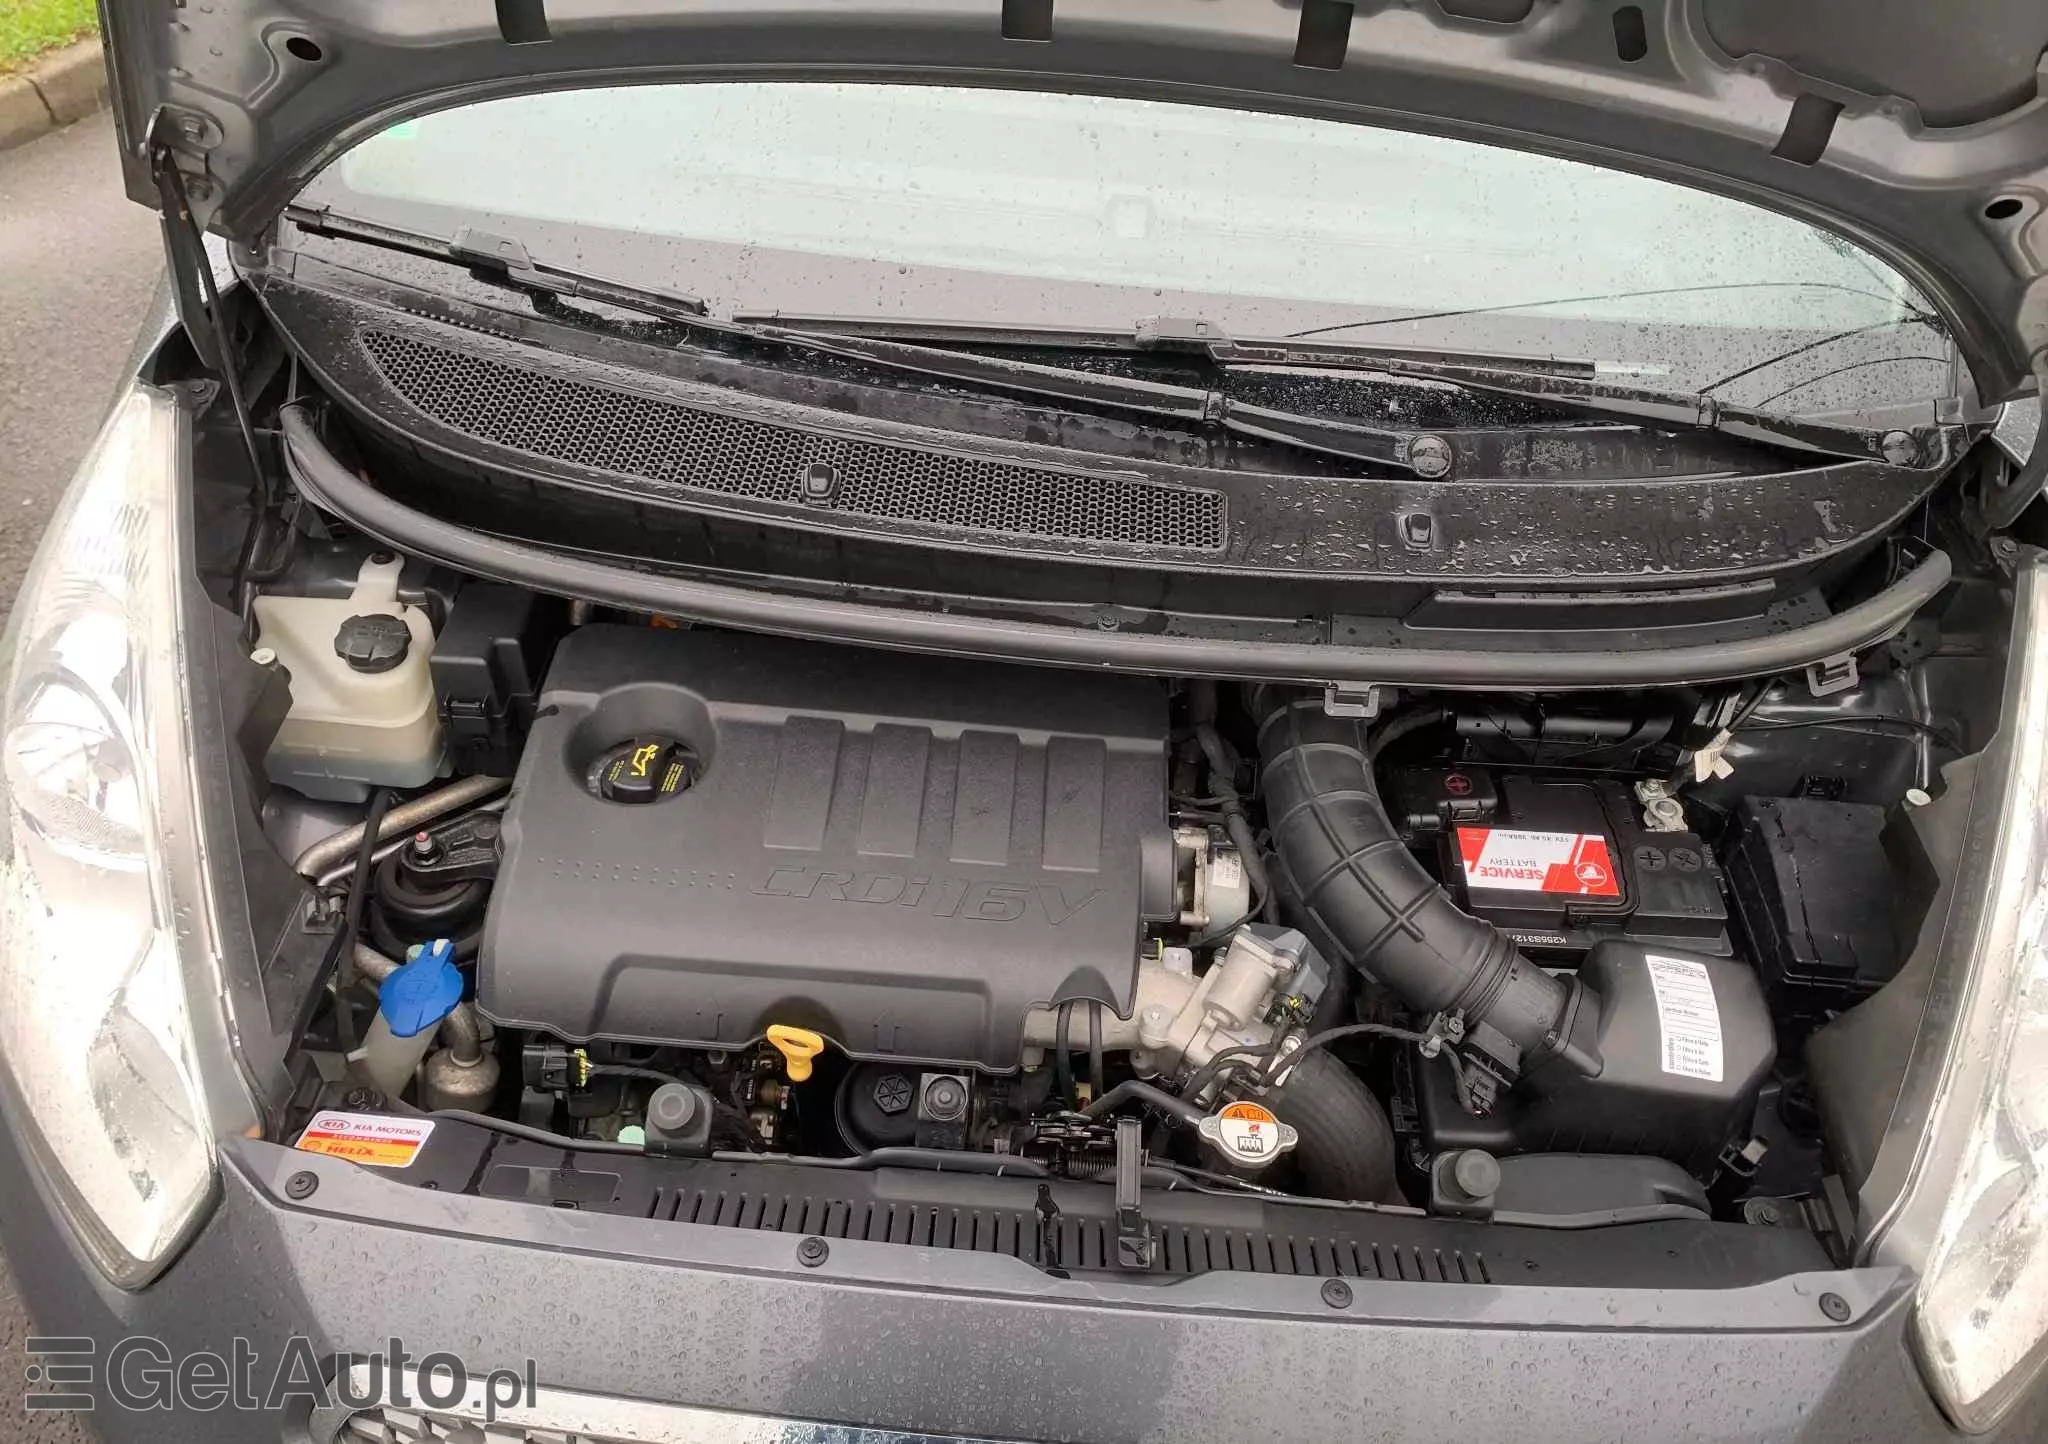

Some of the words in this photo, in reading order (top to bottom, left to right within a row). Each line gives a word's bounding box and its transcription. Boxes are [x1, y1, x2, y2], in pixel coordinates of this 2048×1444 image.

[1489, 857, 1536, 867] BATTERY
[1480, 866, 1544, 880] SERVICE
[324, 1121, 345, 1129] KIA
[376, 1127, 422, 1137] MOTORS
[326, 1146, 375, 1156] HELIX
